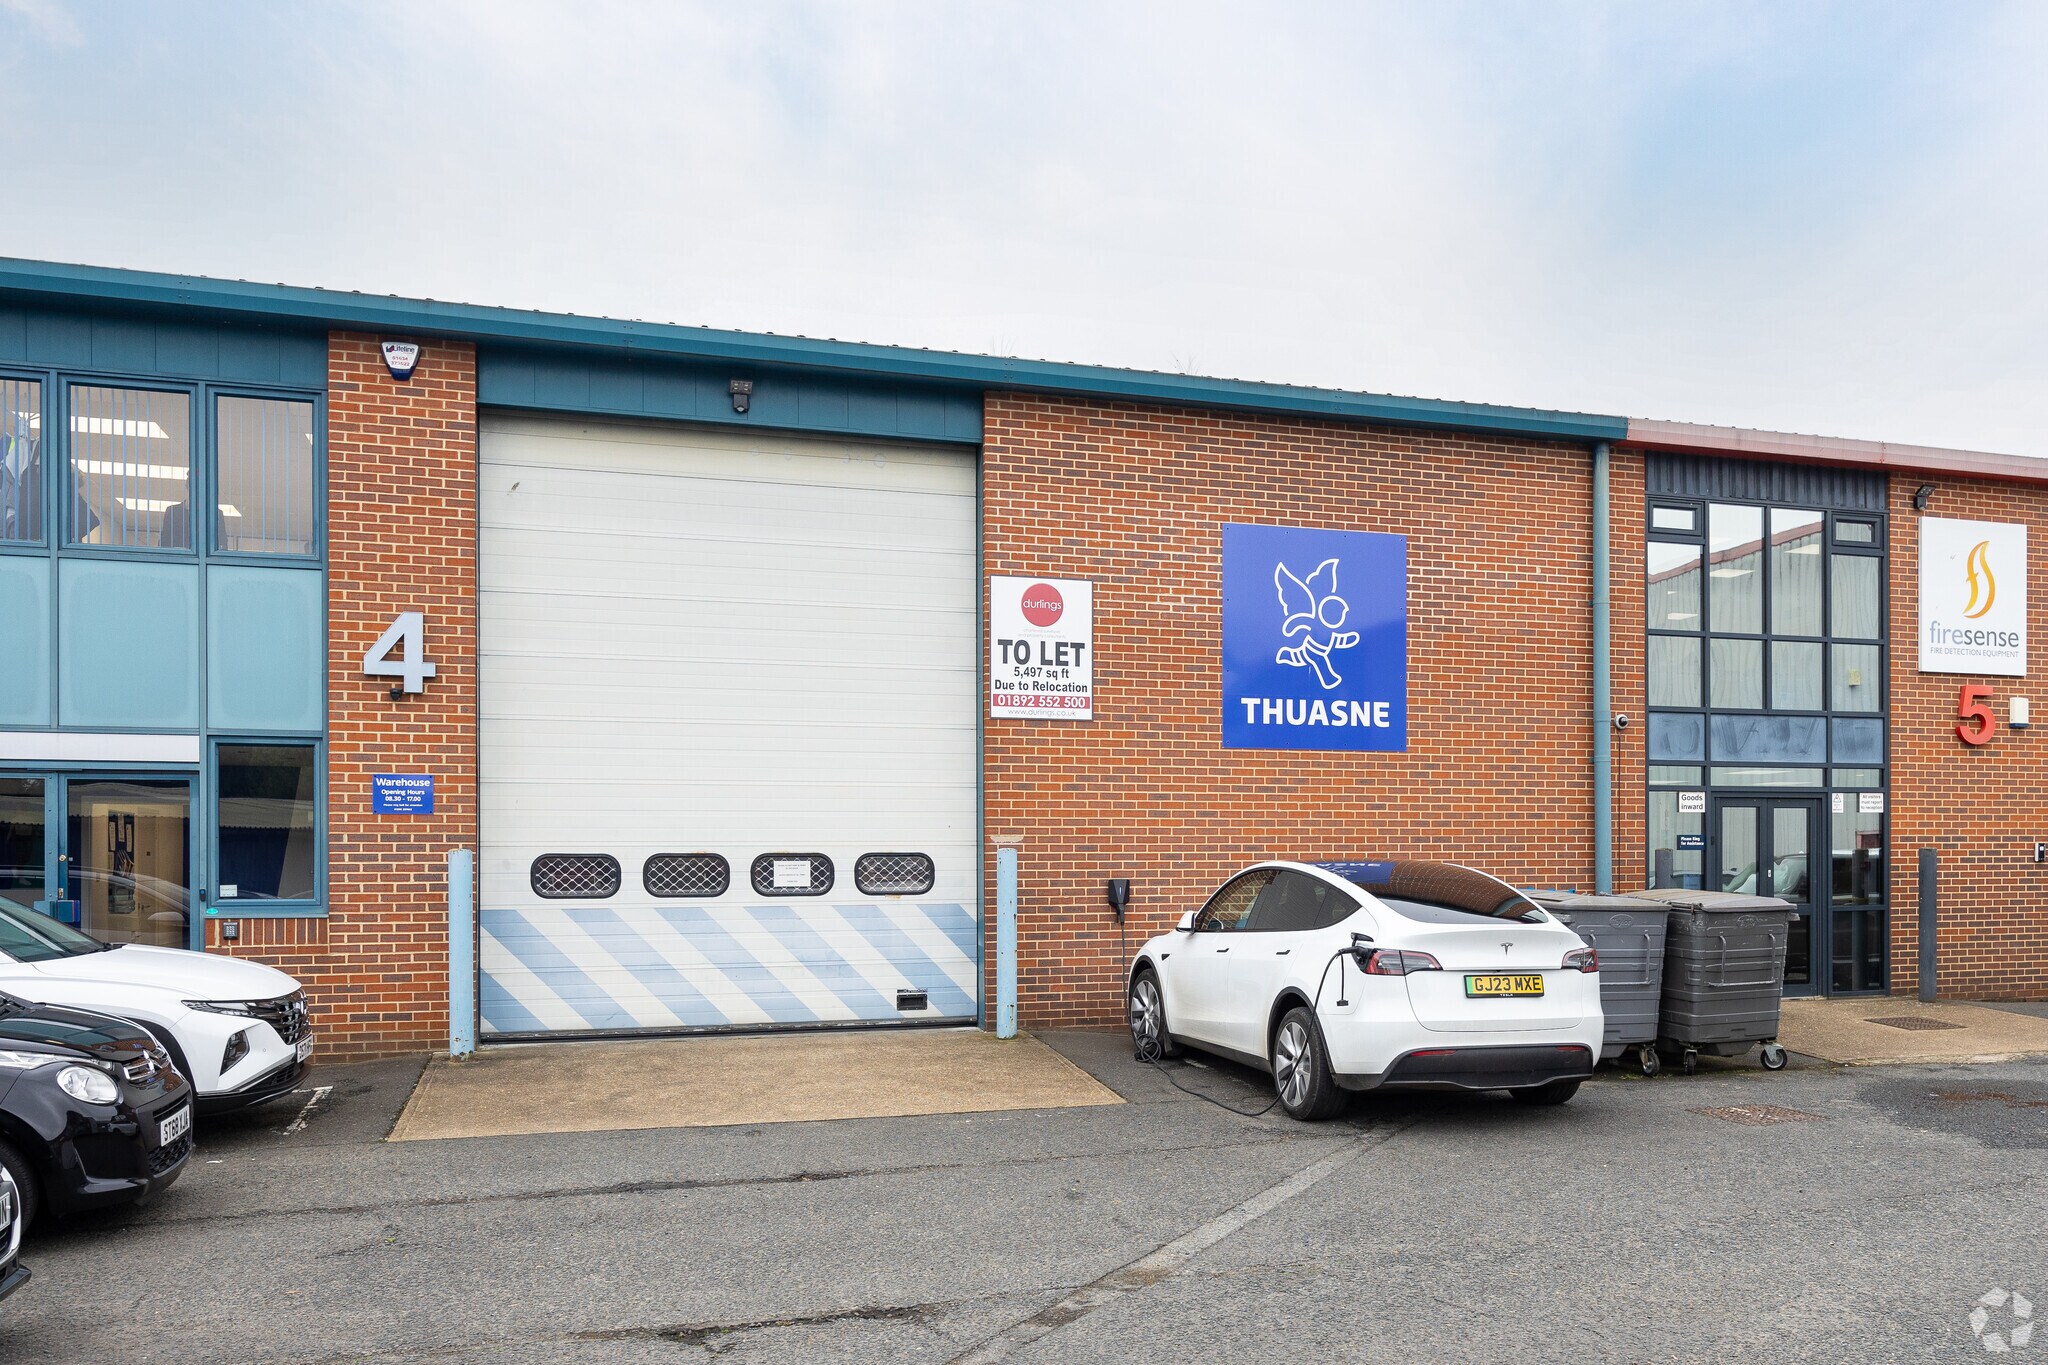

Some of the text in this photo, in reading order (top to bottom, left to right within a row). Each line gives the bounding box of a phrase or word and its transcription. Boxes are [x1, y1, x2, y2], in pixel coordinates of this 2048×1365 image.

[1022, 599, 1062, 612] durlings
[1929, 620, 2020, 648] firesense
[364, 611, 436, 693] 4
[997, 639, 1085, 667] TO LET
[1930, 647, 2019, 659] FIRE DETECTION EQUIPMENT
[1014, 666, 1070, 681] 5,497 sq ft
[994, 679, 1088, 693] Due to Relocation
[997, 694, 1086, 708] 01892 552 500
[1007, 708, 1077, 718] www.durlings.co.uk
[1240, 697, 1390, 728] THUASNE
[1955, 685, 1997, 746] 5
[376, 777, 431, 787] Warehouse
[1681, 793, 1703, 801] Goods
[1474, 977, 1542, 992] GJ23 MXE
